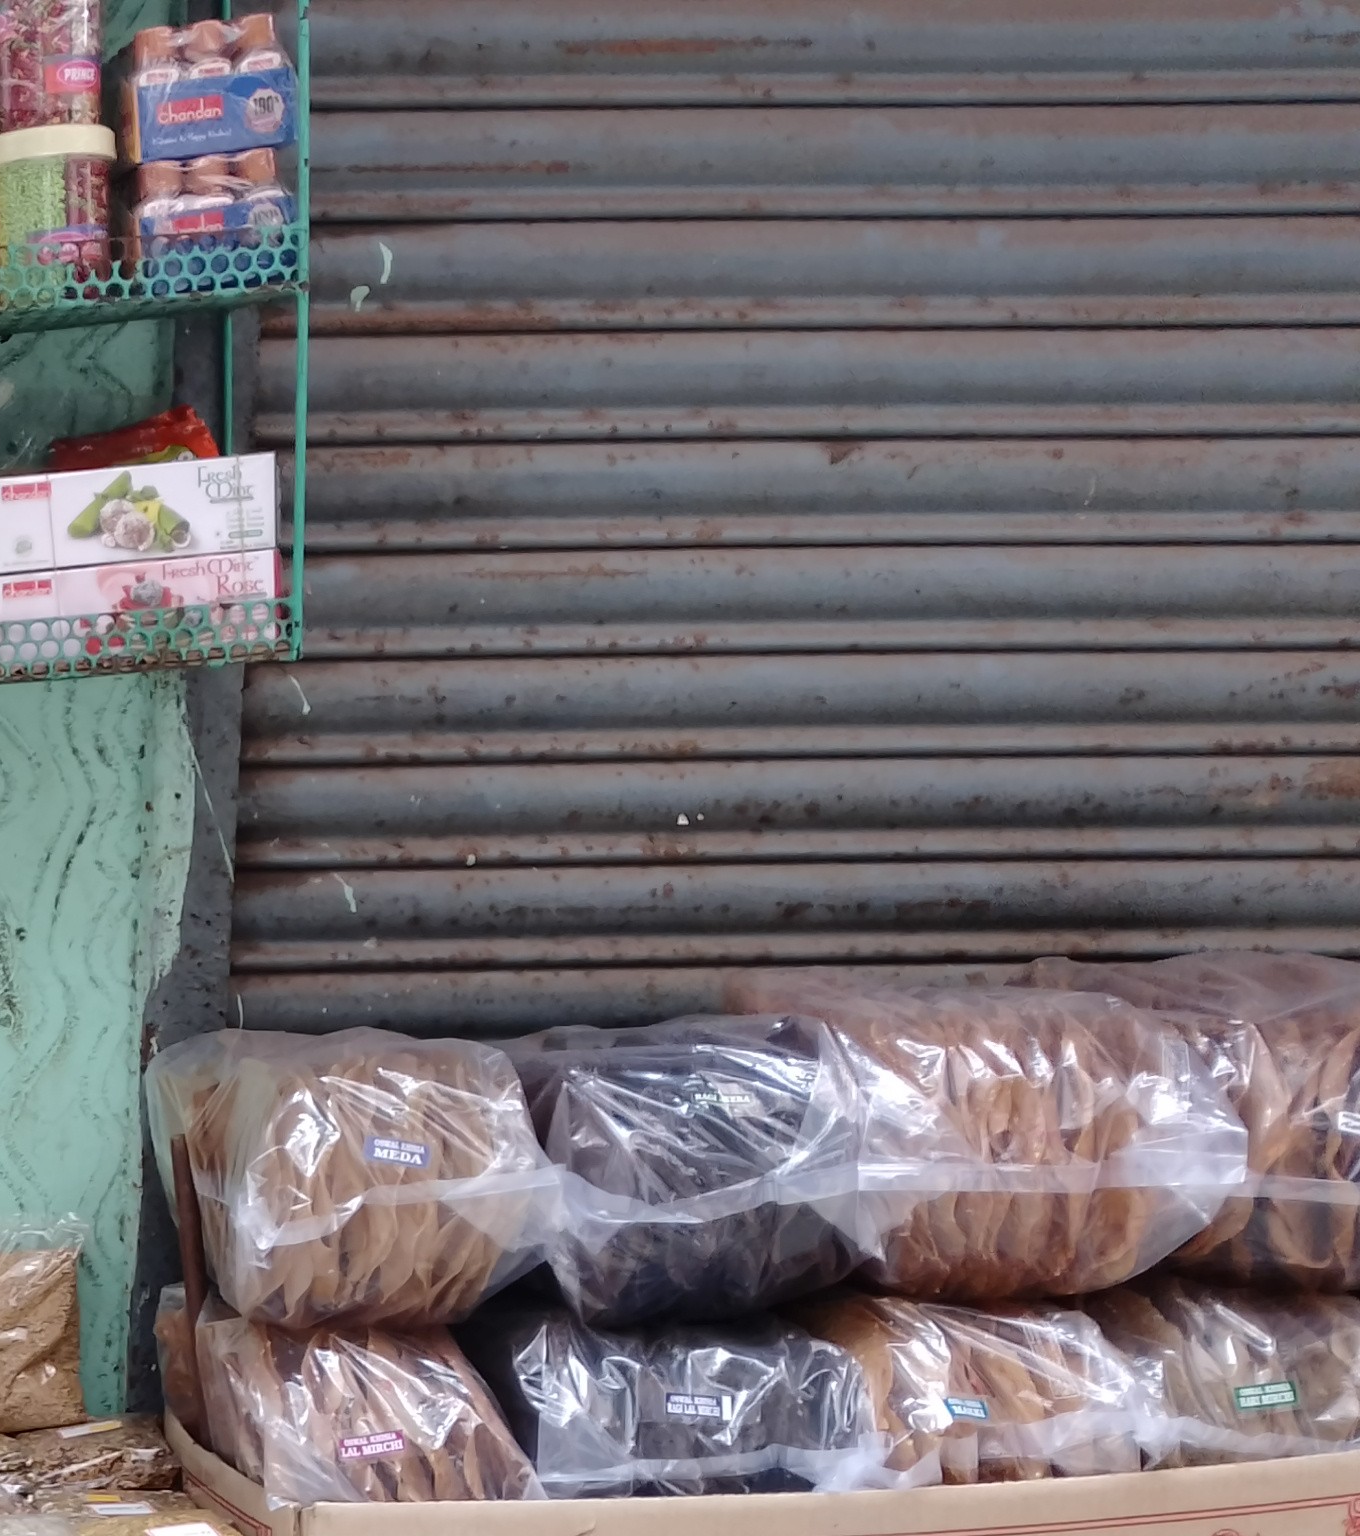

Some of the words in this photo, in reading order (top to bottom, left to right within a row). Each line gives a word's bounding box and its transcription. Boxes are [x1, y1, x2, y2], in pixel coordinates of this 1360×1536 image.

[64, 68, 95, 81] PRINCE
[373, 1147, 423, 1165] MEDA
[341, 1446, 361, 1457] LAL
[362, 1439, 403, 1455] MIRCHI
